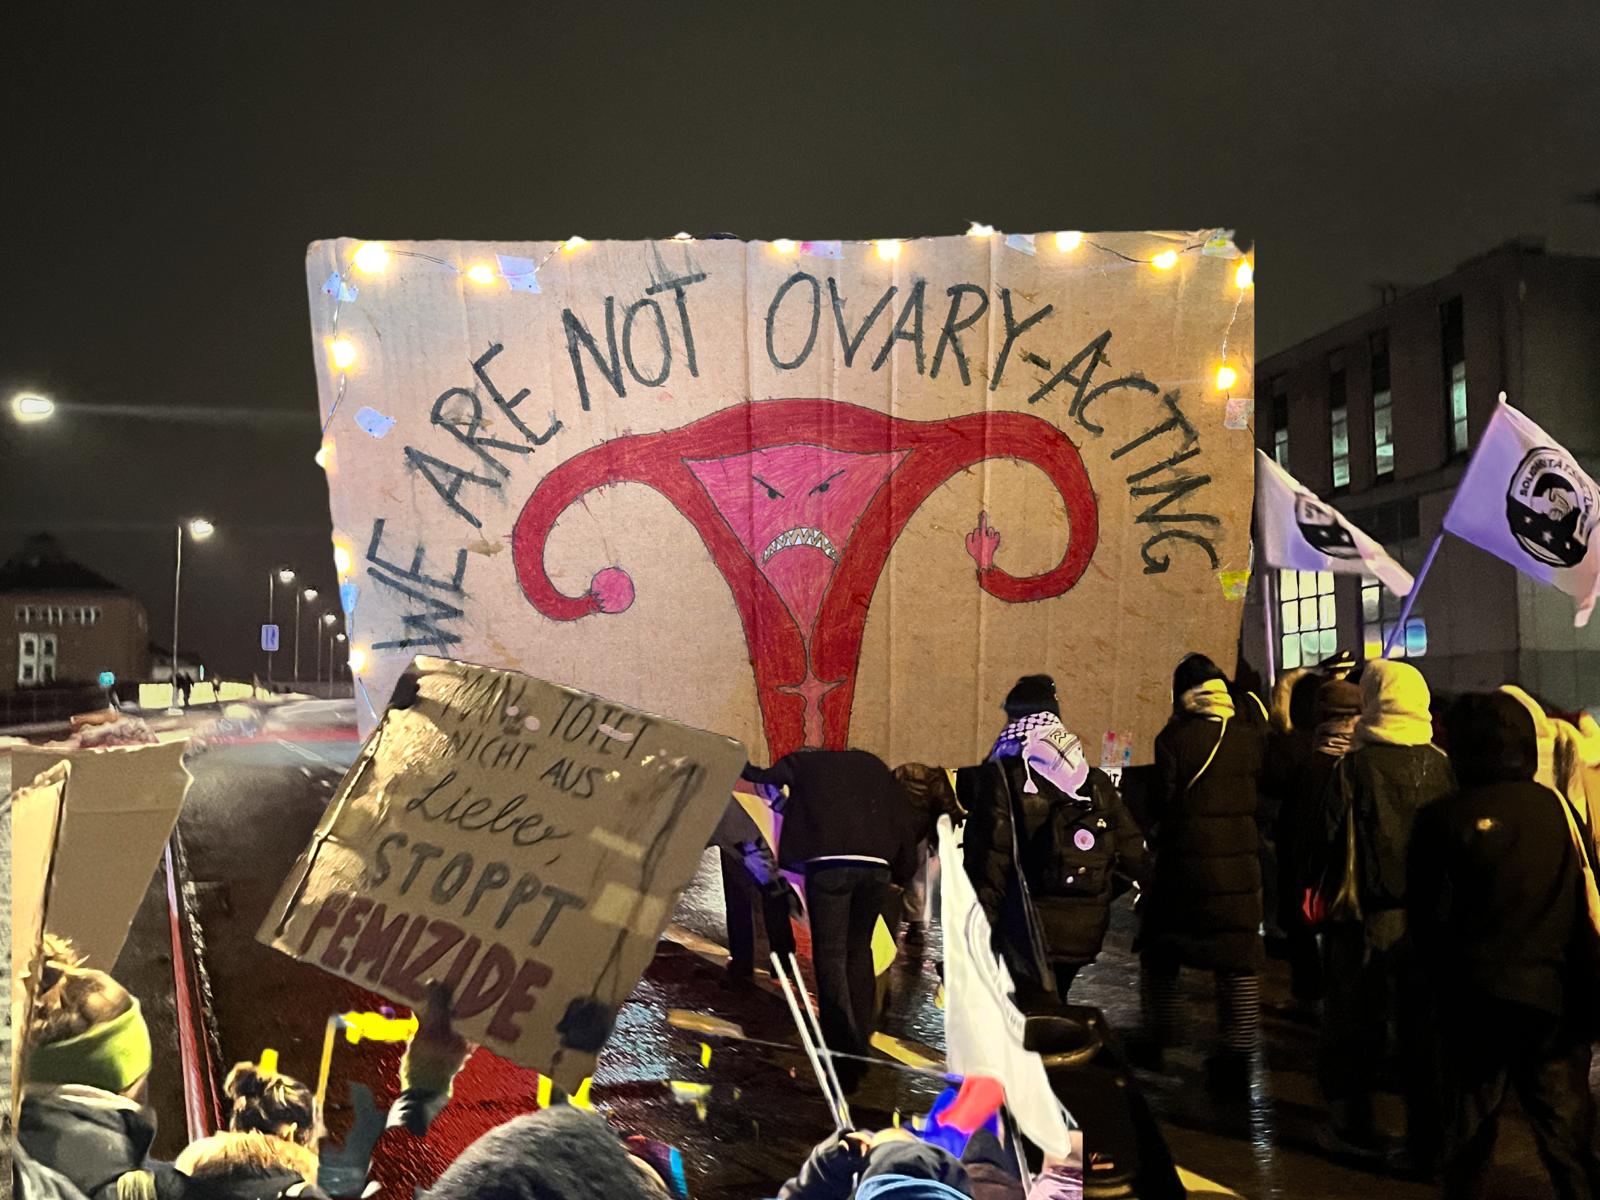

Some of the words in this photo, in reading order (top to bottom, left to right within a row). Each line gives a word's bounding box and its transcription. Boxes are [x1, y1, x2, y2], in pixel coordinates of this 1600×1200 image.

[562, 272, 710, 411] NOT
[403, 343, 564, 528] ARE
[366, 518, 468, 650] WE
[441, 730, 537, 769] NICHT
[539, 757, 604, 798] AUS
[367, 832, 587, 947] STOPPT
[301, 891, 553, 1042] FEMIZIDE
